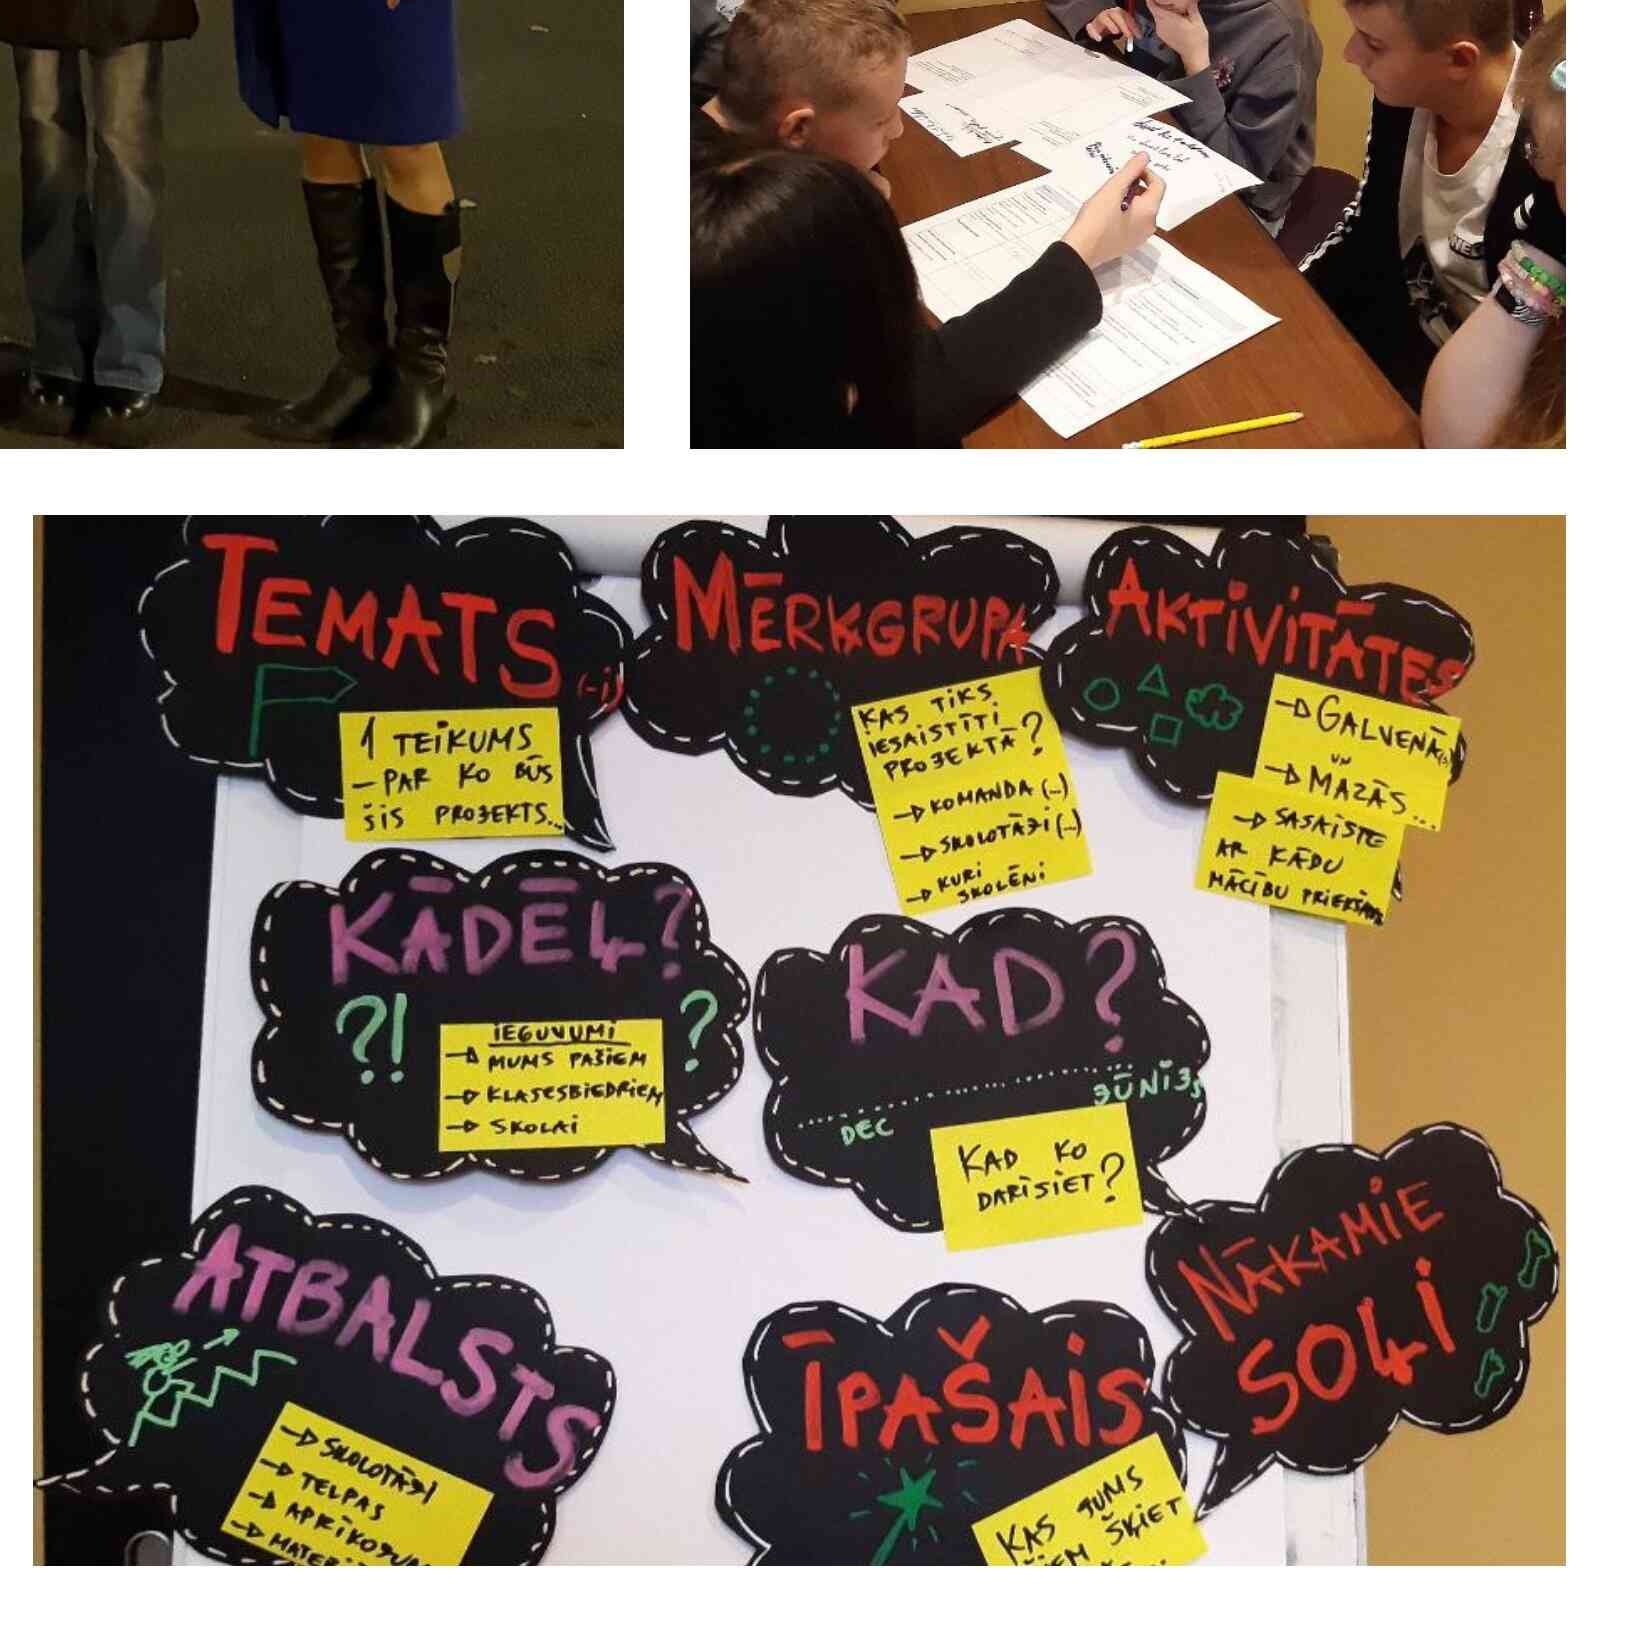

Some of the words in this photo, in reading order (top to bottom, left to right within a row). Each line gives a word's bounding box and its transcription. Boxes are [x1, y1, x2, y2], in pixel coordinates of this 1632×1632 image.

[201, 533, 562, 701] TEMATS
[857, 704, 910, 730] KAS
[459, 762, 492, 791] KO
[930, 779, 1034, 815] KOMANDA
[487, 1051, 555, 1073] MUMS
[957, 1143, 1020, 1184] KAD
[1053, 1137, 1089, 1165] KO
[1178, 1175, 1445, 1342] NĀKAMIE
[171, 1222, 604, 1490] ATBALSTS
[781, 1314, 1149, 1453] ĪPAŠAIS
[300, 1471, 386, 1522] TELPAS
[995, 1513, 1056, 1566] KAS
